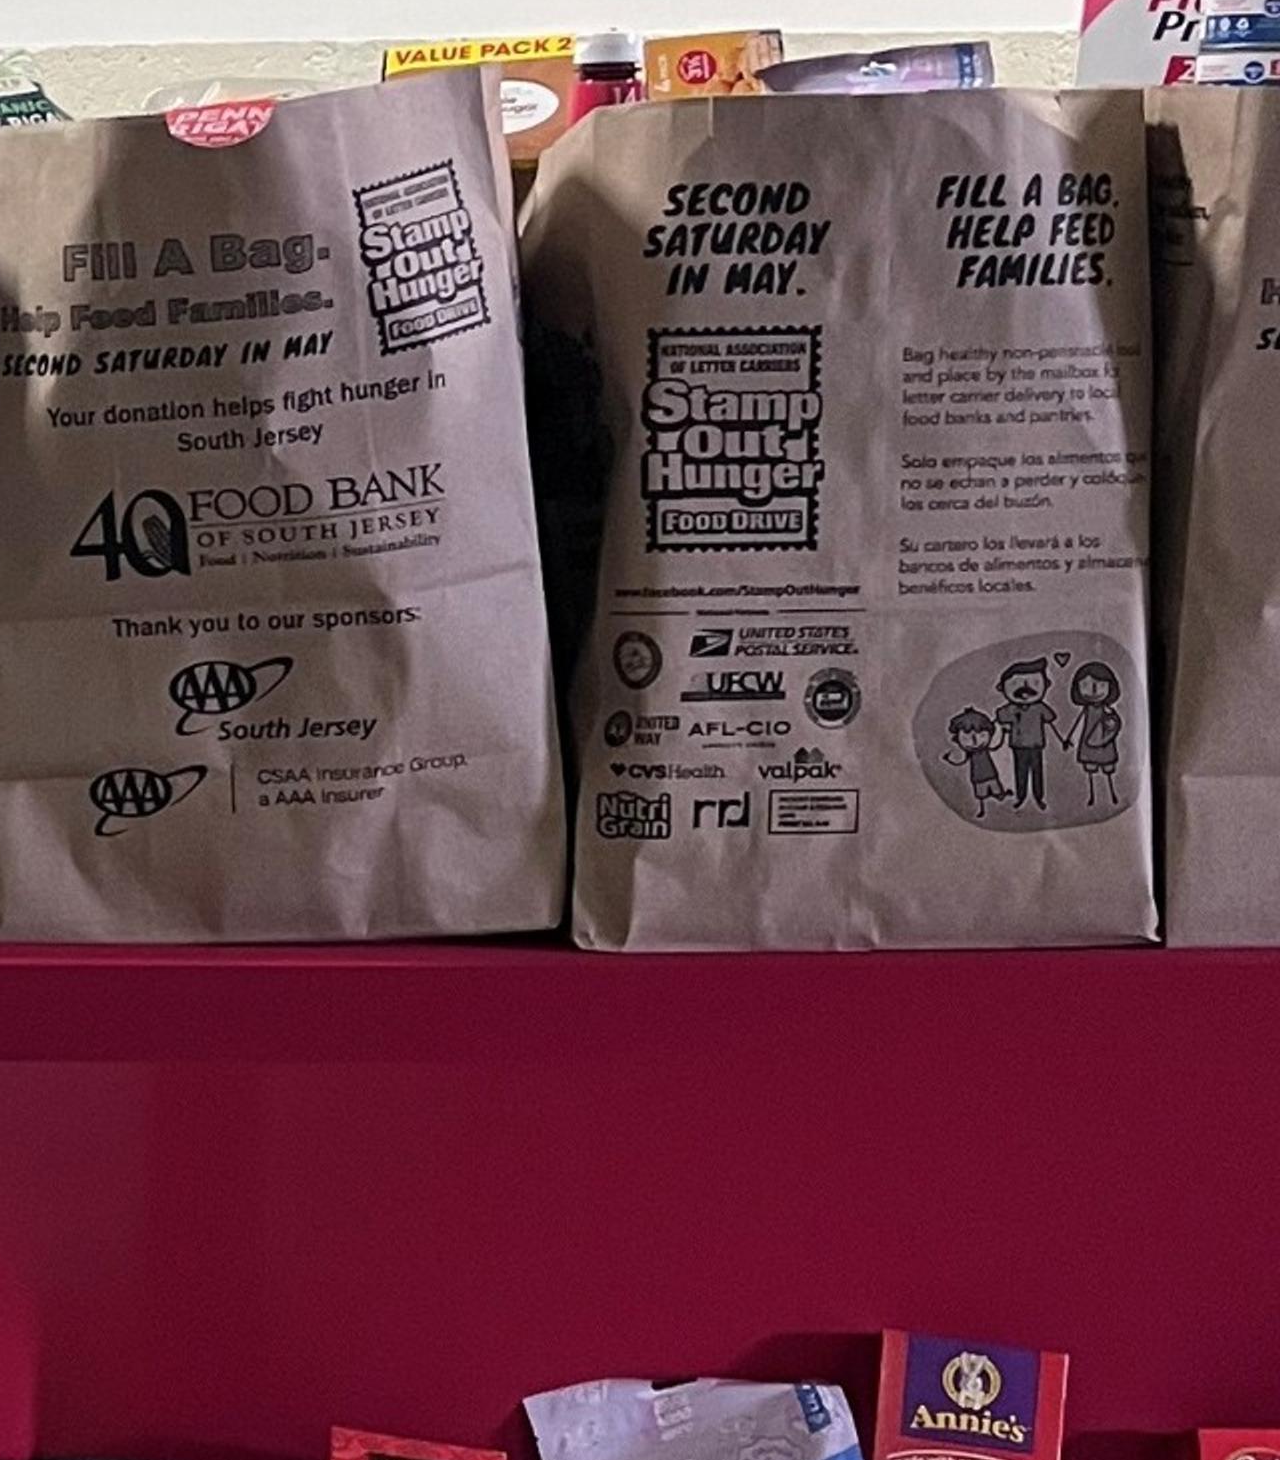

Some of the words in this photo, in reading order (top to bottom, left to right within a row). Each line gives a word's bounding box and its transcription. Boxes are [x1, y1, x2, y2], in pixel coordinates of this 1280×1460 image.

[396, 45, 471, 65] VALUE
[480, 40, 549, 57] PACK
[557, 38, 572, 51] 2
[664, 183, 811, 216] SECOND
[644, 220, 831, 258] SATURDAY
[666, 264, 705, 296] IN
[723, 261, 807, 296] MAY.
[646, 383, 823, 431] Stamp
[685, 424, 787, 458] Out
[646, 452, 824, 502] Hunger
[664, 509, 731, 533] FOOD
[733, 508, 804, 532] DRIVE
[112, 617, 183, 638] Thank
[188, 615, 230, 637] you
[238, 614, 260, 631] to
[268, 612, 307, 630] our
[313, 605, 421, 632] sponsors:
[178, 663, 251, 708] AAA
[218, 720, 291, 741] South
[298, 717, 378, 741] Jersey
[689, 719, 792, 737] AFL-CIO
[257, 767, 312, 785] CSAA
[316, 760, 405, 782] Insurance
[759, 760, 837, 785] valpak
[276, 788, 316, 805] AAA
[321, 784, 385, 803] Insurer
[910, 1405, 1026, 1443] Annie's
